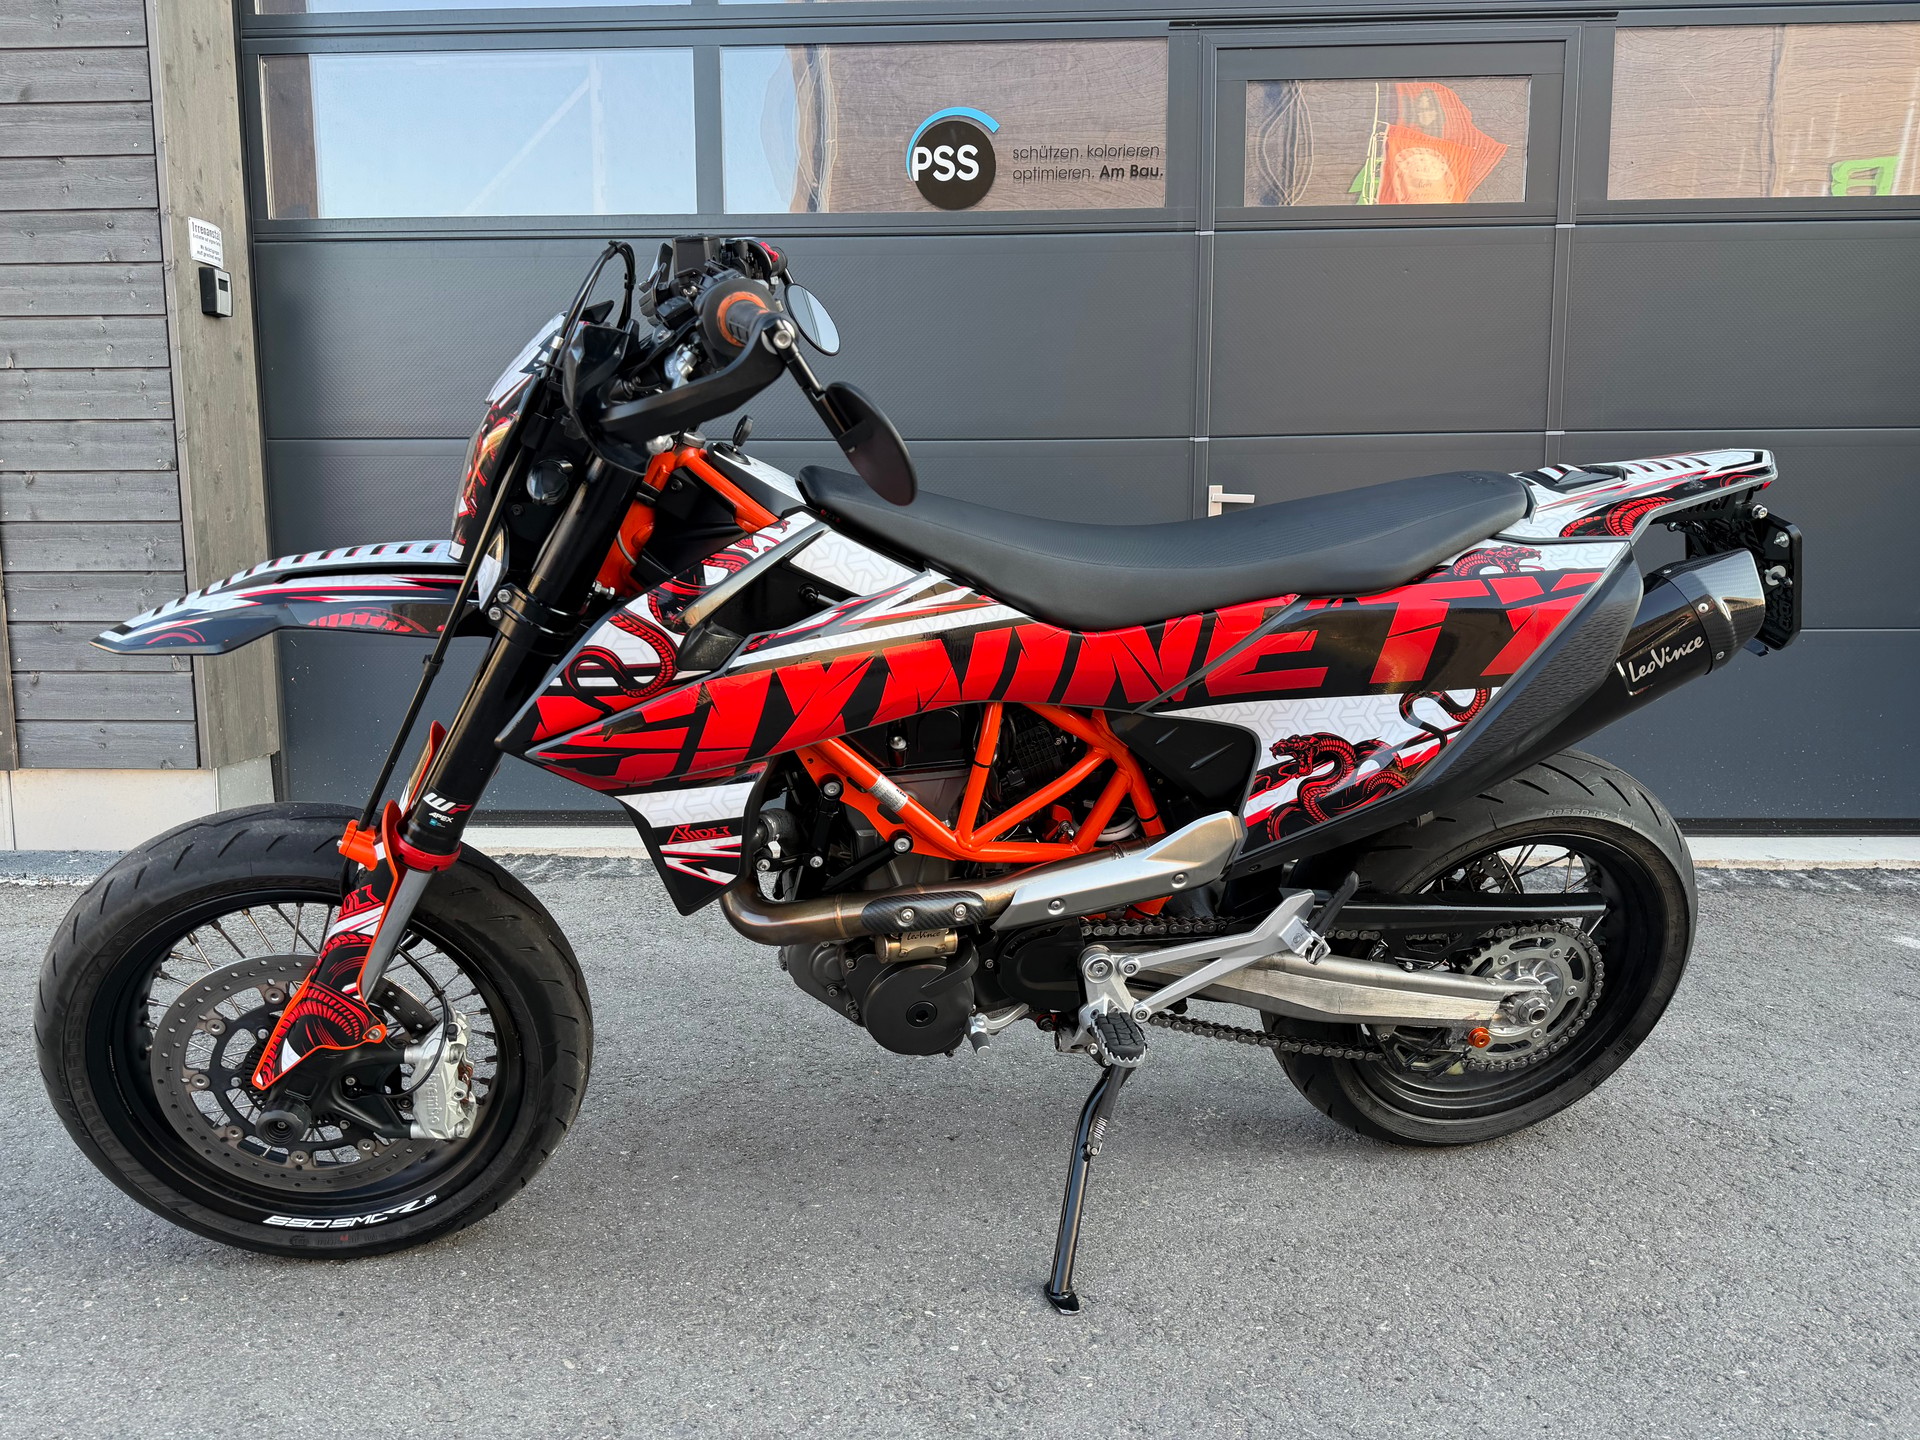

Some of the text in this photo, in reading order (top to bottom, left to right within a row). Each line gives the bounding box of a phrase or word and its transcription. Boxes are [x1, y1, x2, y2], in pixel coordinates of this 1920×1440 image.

[912, 144, 980, 182] PSS
[1012, 144, 1160, 160] schützen. kolorieren
[1012, 164, 1164, 184] optimieren. Am Bau.
[1628, 636, 1705, 683] LeoVince
[428, 812, 454, 823] APEX
[424, 1073, 442, 1123] brembo
